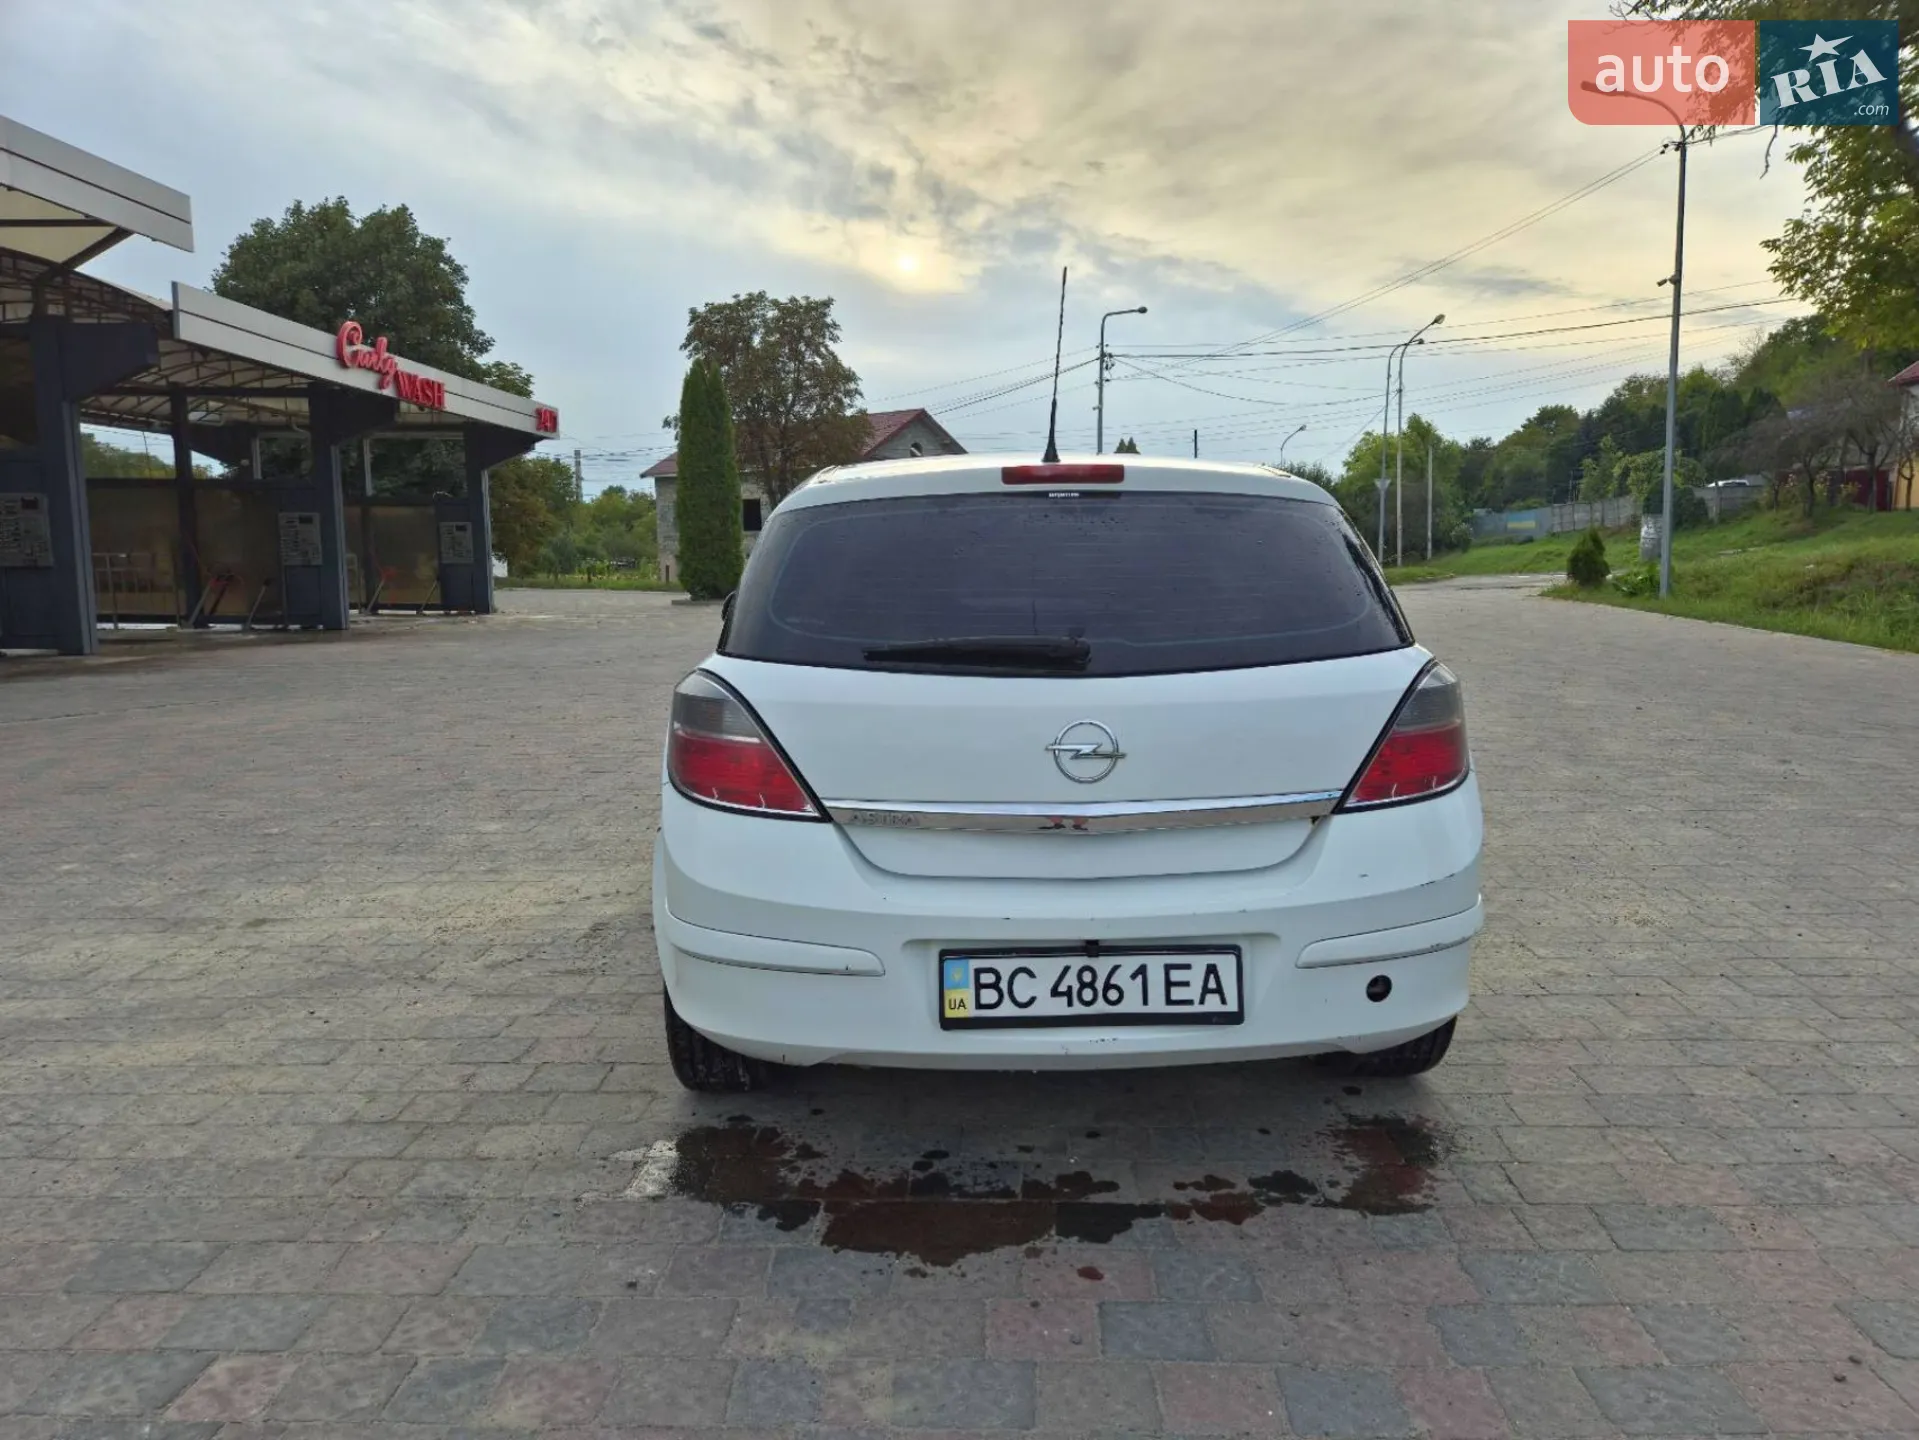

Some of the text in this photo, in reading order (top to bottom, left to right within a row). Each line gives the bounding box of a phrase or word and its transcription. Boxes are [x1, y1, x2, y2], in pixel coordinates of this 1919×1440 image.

[394, 370, 445, 410] WASH
[948, 999, 967, 1011] UA
[973, 963, 1228, 1010] BC 4861 EA
